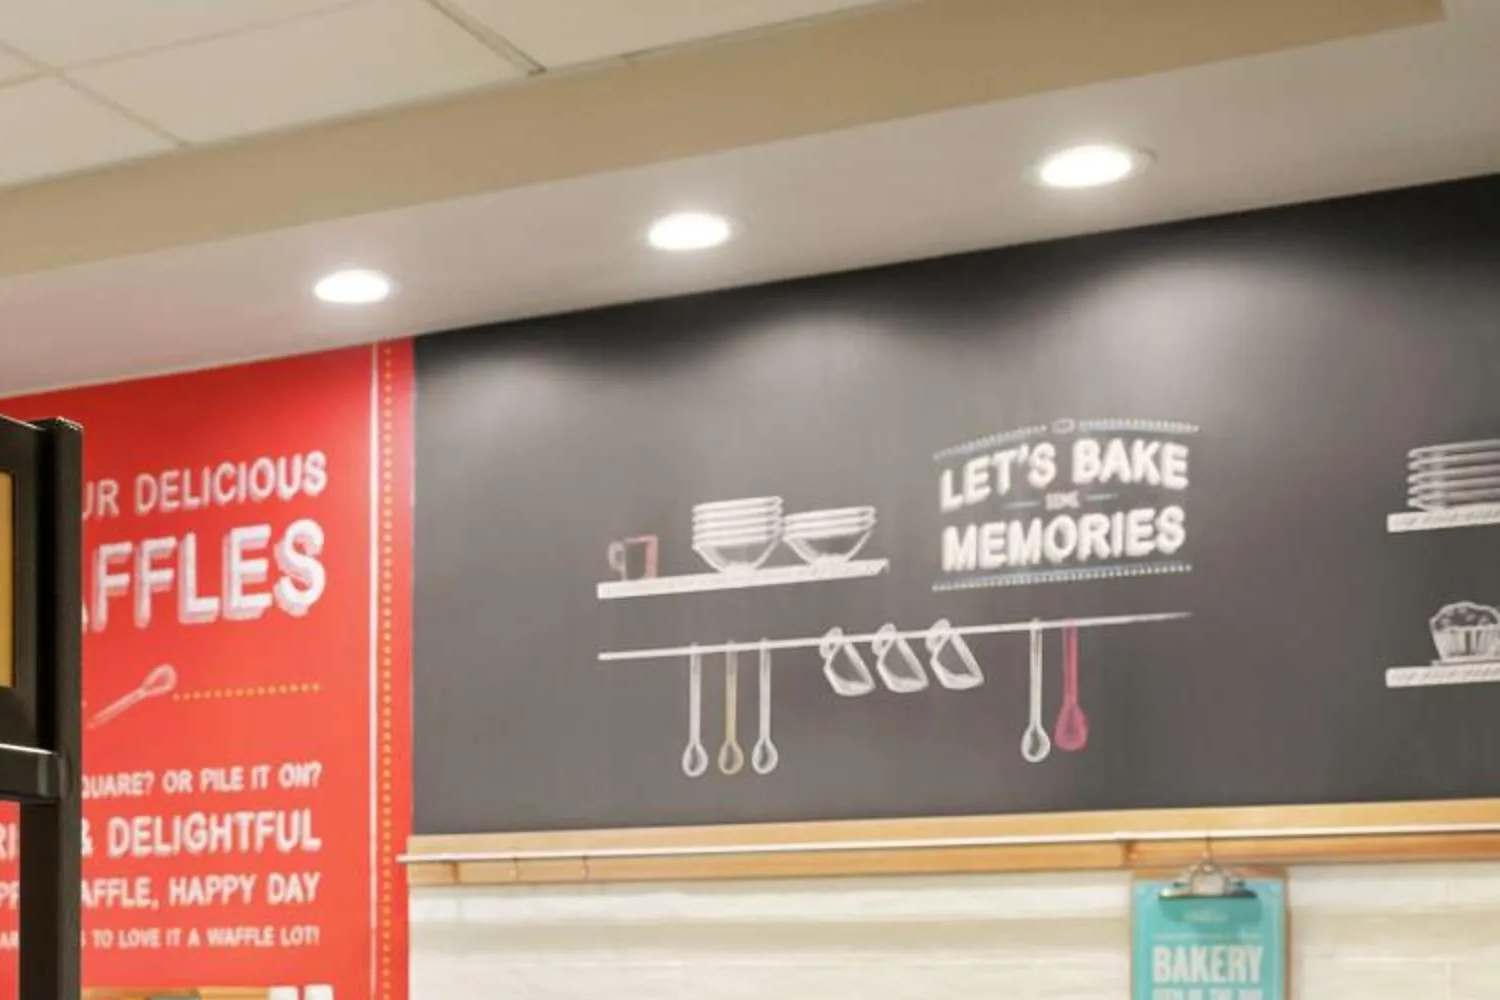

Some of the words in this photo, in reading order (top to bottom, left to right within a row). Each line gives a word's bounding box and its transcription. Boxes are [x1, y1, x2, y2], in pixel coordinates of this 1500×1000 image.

[134, 450, 328, 516] DELICIOUS
[940, 441, 1058, 512] LET'S
[1072, 437, 1190, 490] BAKE
[941, 505, 1187, 572] MEMORIES
[82, 518, 326, 634] FFLES
[162, 766, 193, 794] OR
[200, 766, 245, 792] PILE
[252, 764, 270, 788] IT
[278, 761, 323, 788] ON?
[107, 808, 322, 860] DELIGHTFUL
[81, 875, 160, 912] AFFLE,
[169, 873, 258, 907] HAPPY
[267, 871, 321, 906] DAY
[92, 928, 114, 949] TO
[165, 928, 182, 947] IT
[187, 928, 200, 946] A
[207, 927, 275, 947] WAFFLE
[1152, 944, 1264, 984] BAKERY
